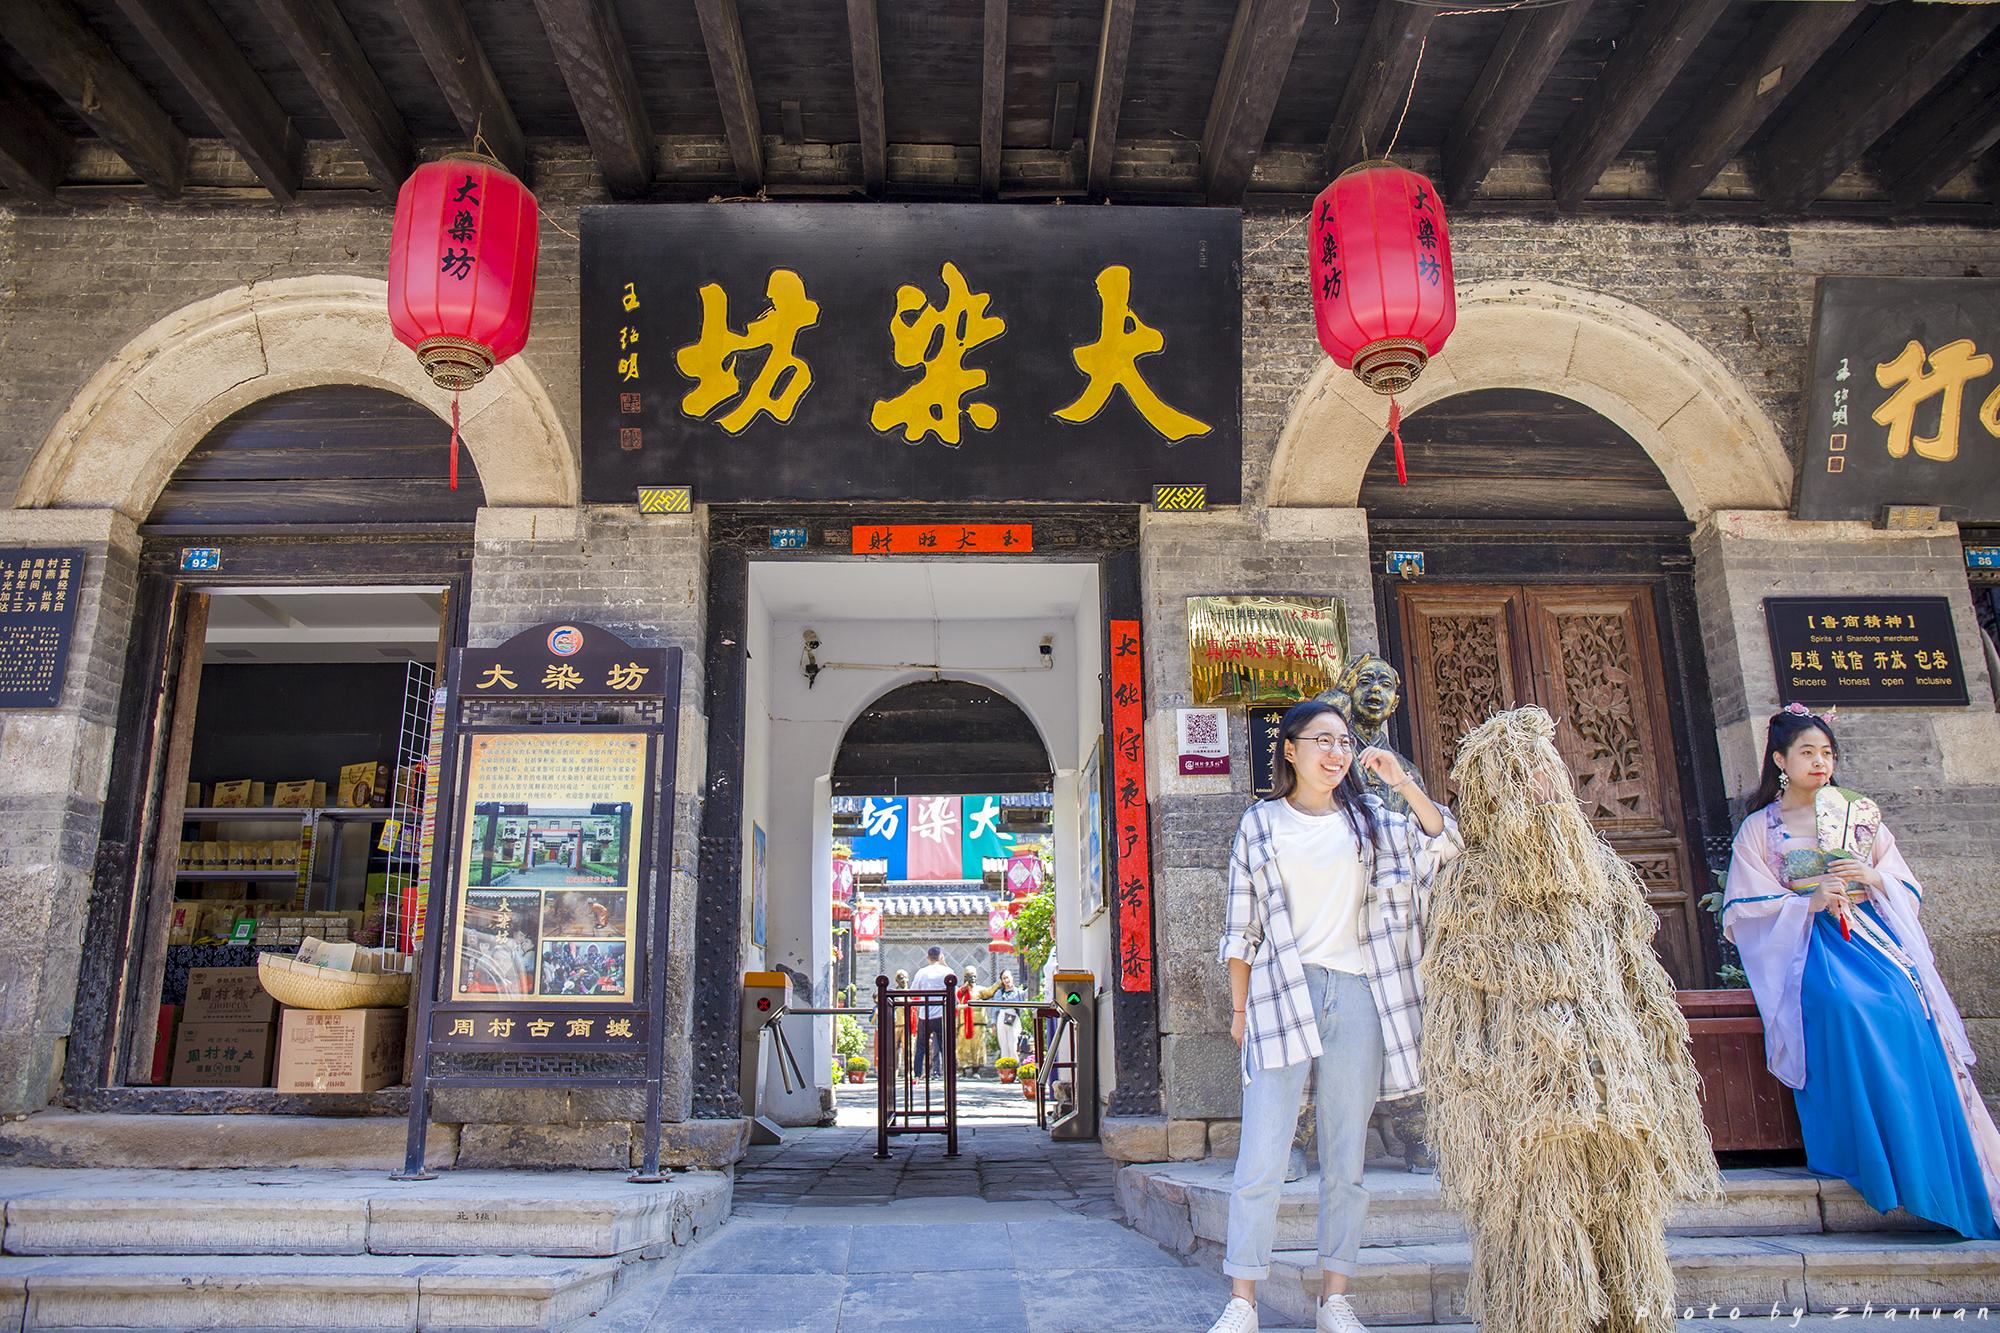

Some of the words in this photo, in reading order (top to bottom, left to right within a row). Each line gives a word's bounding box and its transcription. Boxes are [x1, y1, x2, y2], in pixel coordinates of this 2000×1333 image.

[441, 175, 479, 281] 大染坊
[1413, 185, 1442, 287] 大染坊
[1318, 200, 1344, 301] 大染坊
[676, 262, 1214, 445] 大染坊
[1872, 338, 2000, 462] 行
[780, 538, 796, 547] 90
[192, 559, 208, 568] 92
[1205, 637, 1337, 660] 真实故事发生地
[1810, 635, 1833, 643] Spirits
[1846, 635, 1881, 643] Shandong
[1790, 651, 1823, 672] 厚道
[1832, 650, 1864, 671] 诚信
[1874, 650, 1907, 671] 开放
[1915, 650, 1949, 670] 包容
[476, 662, 650, 690] 大染坊
[1792, 677, 1827, 687] Sincere
[1839, 677, 1871, 686] Honest
[1882, 678, 1904, 687] open
[1916, 676, 1952, 686] Inclusive
[862, 796, 1014, 843] 大染坊
[448, 1018, 634, 1039] 周村古商城
